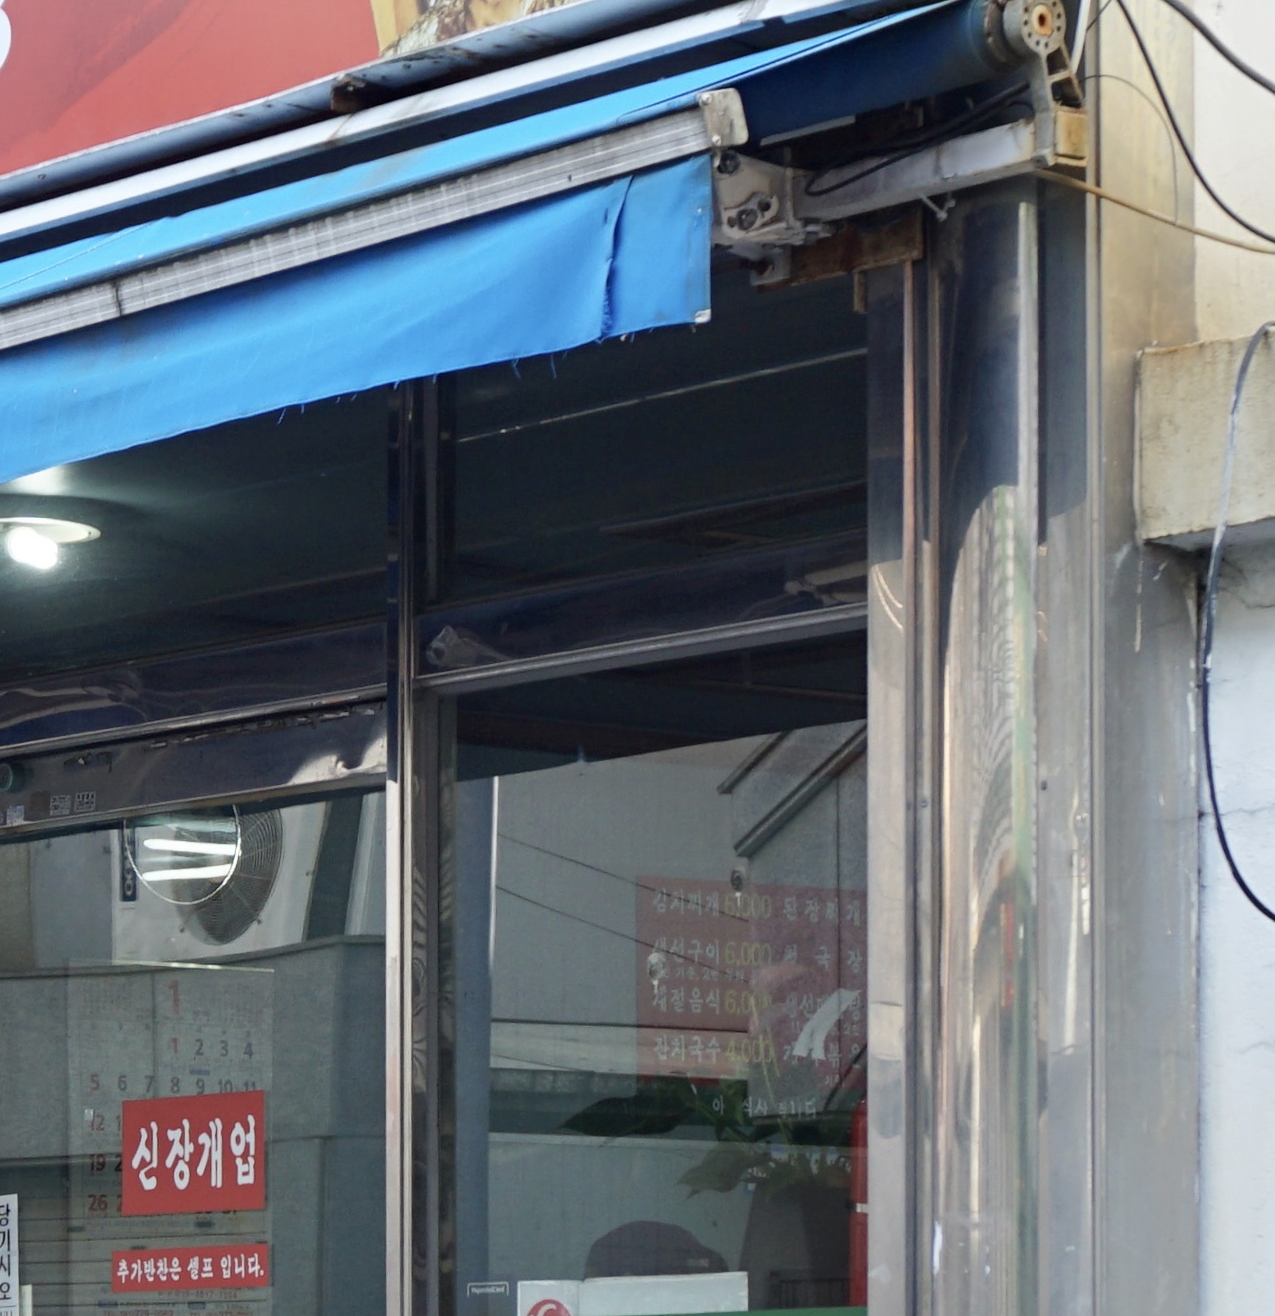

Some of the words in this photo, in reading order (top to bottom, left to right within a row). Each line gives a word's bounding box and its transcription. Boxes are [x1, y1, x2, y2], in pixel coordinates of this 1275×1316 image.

[131, 1113, 257, 1192] 신장개업
[116, 1256, 183, 1285] 추가반찬은
[186, 1255, 215, 1280] 셀프
[219, 1252, 265, 1280] 입니다.
